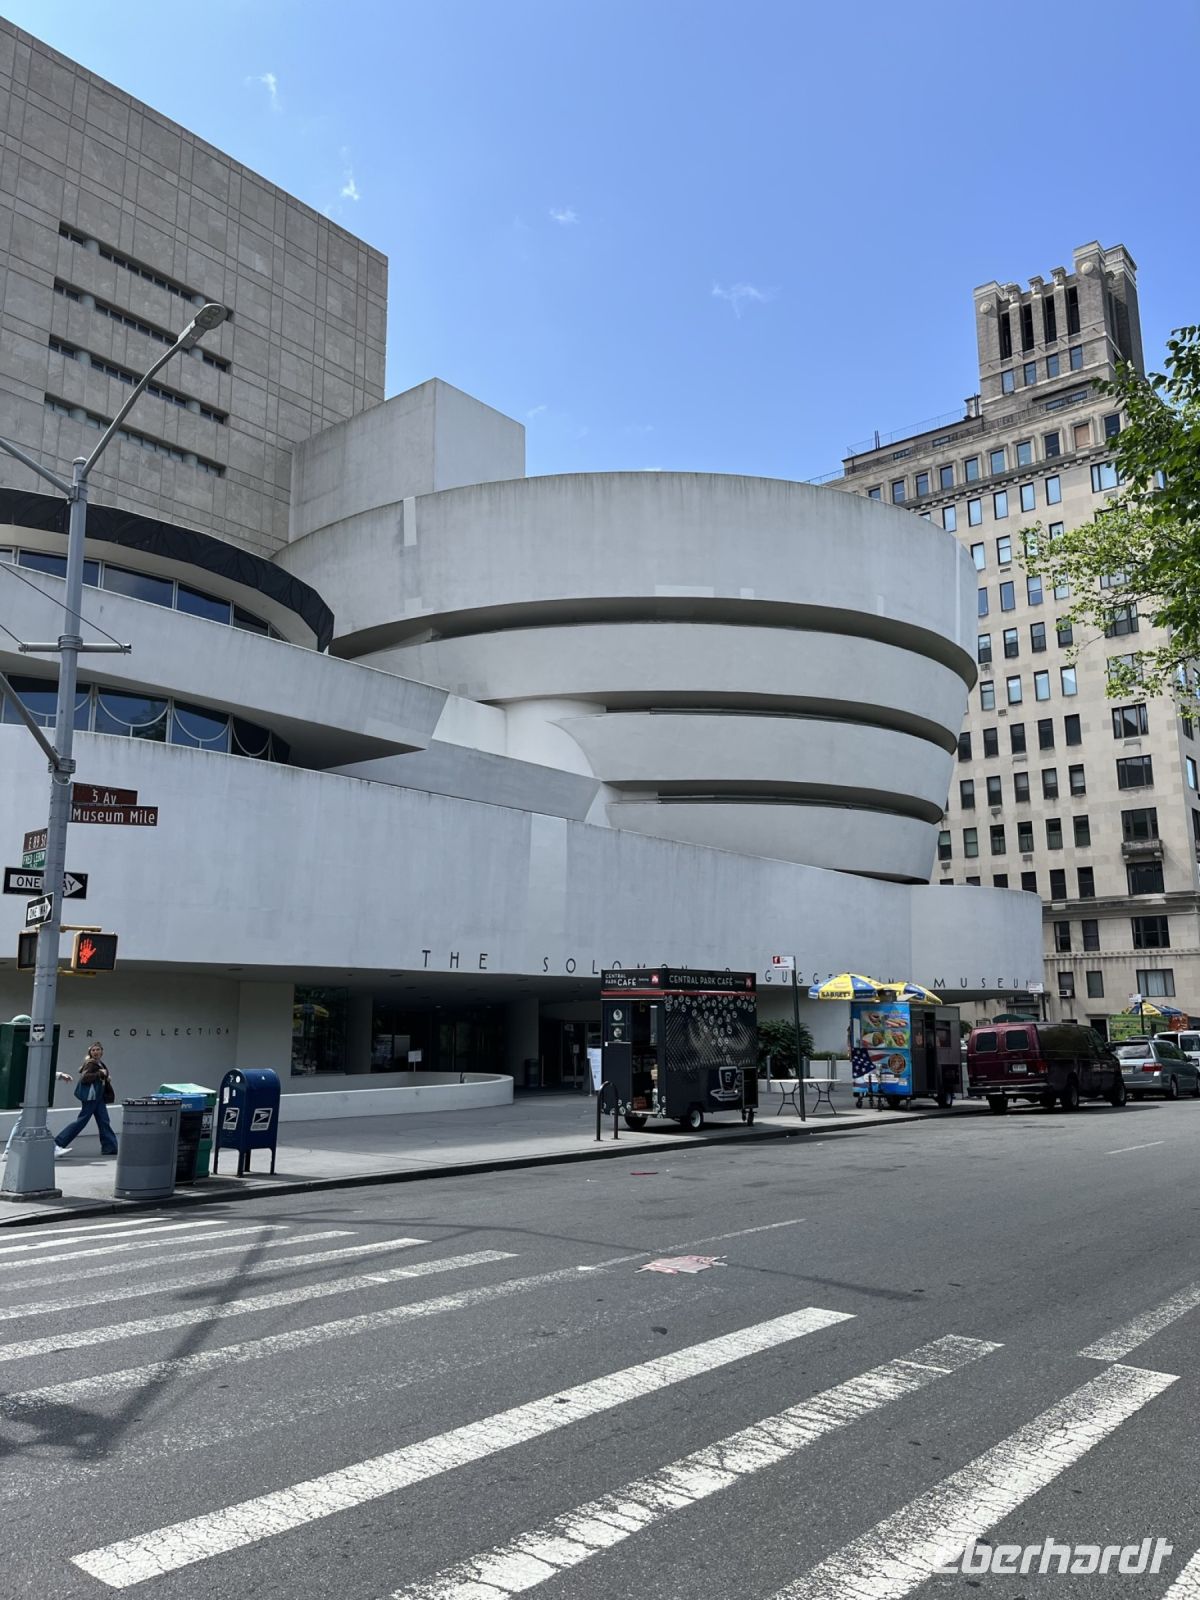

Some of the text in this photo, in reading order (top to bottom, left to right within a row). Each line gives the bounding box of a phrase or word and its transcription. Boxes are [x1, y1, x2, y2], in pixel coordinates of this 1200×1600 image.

[92, 789, 117, 806] 5 Av
[72, 807, 155, 825] Museum Mile
[16, 876, 76, 891] ONE AY
[29, 903, 49, 919] ONE WAY
[422, 950, 488, 970] THE
[617, 976, 637, 986] CAFÉ
[669, 974, 699, 984] CENTRAL
[699, 975, 716, 985] PARK
[716, 975, 733, 986] CAFÉ
